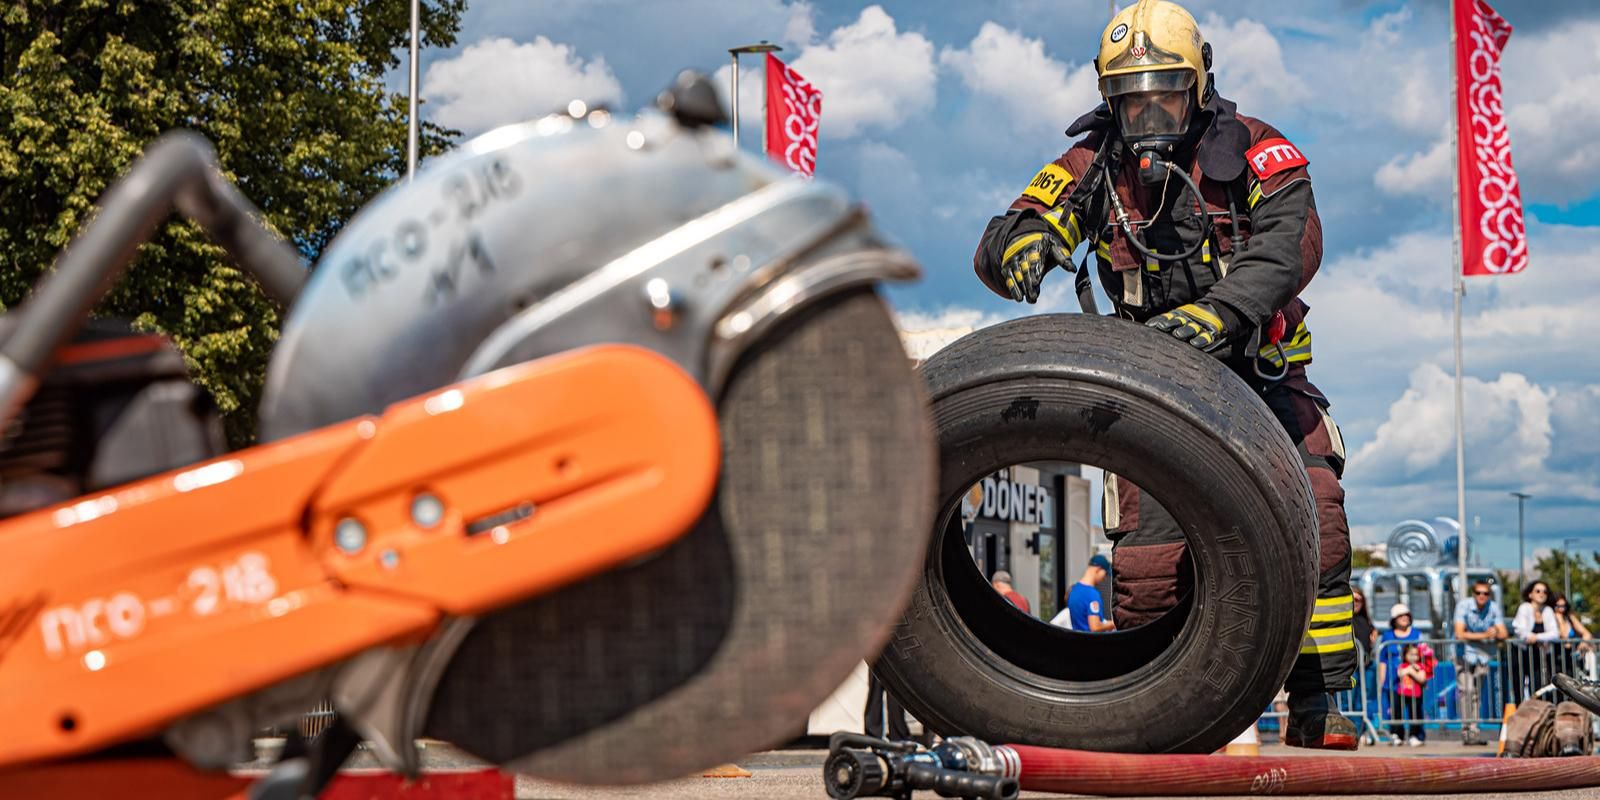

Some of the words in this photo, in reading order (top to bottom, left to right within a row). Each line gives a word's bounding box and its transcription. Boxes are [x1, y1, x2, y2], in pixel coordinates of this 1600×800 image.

[1252, 144, 1301, 172] РТП
[1030, 172, 1064, 195] 2061
[983, 467, 1048, 524] DÖNER
